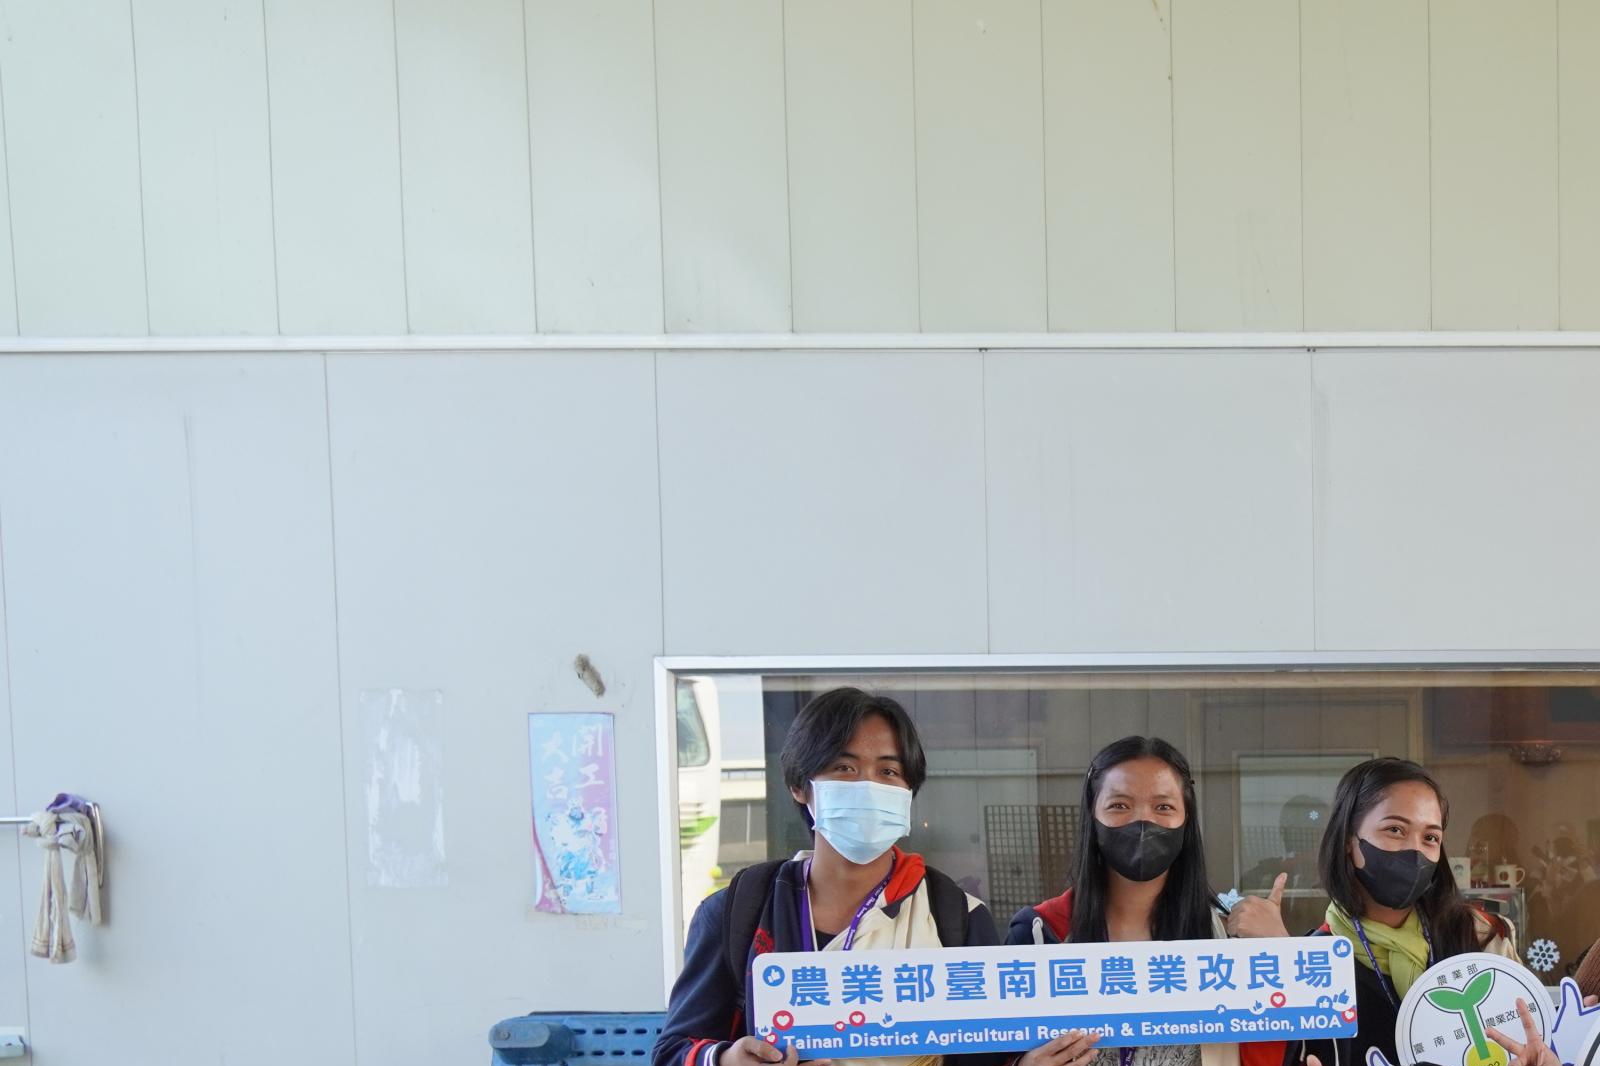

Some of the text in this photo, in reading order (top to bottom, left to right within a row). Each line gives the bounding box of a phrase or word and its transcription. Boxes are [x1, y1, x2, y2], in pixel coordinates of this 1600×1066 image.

[788, 950, 1333, 1008] 農業部臺南區農業改良場
[1436, 963, 1479, 986] 農業部
[783, 1034, 843, 1050] Tainan
[850, 1031, 919, 1048] District
[925, 1026, 1030, 1048] Agricultural
[1120, 1022, 1135, 1037] &
[1141, 1018, 1225, 1036] Extension
[1230, 1015, 1295, 1033] Station,
[1301, 1014, 1342, 1029] MOA
[1412, 1028, 1466, 1055] 臺南區
